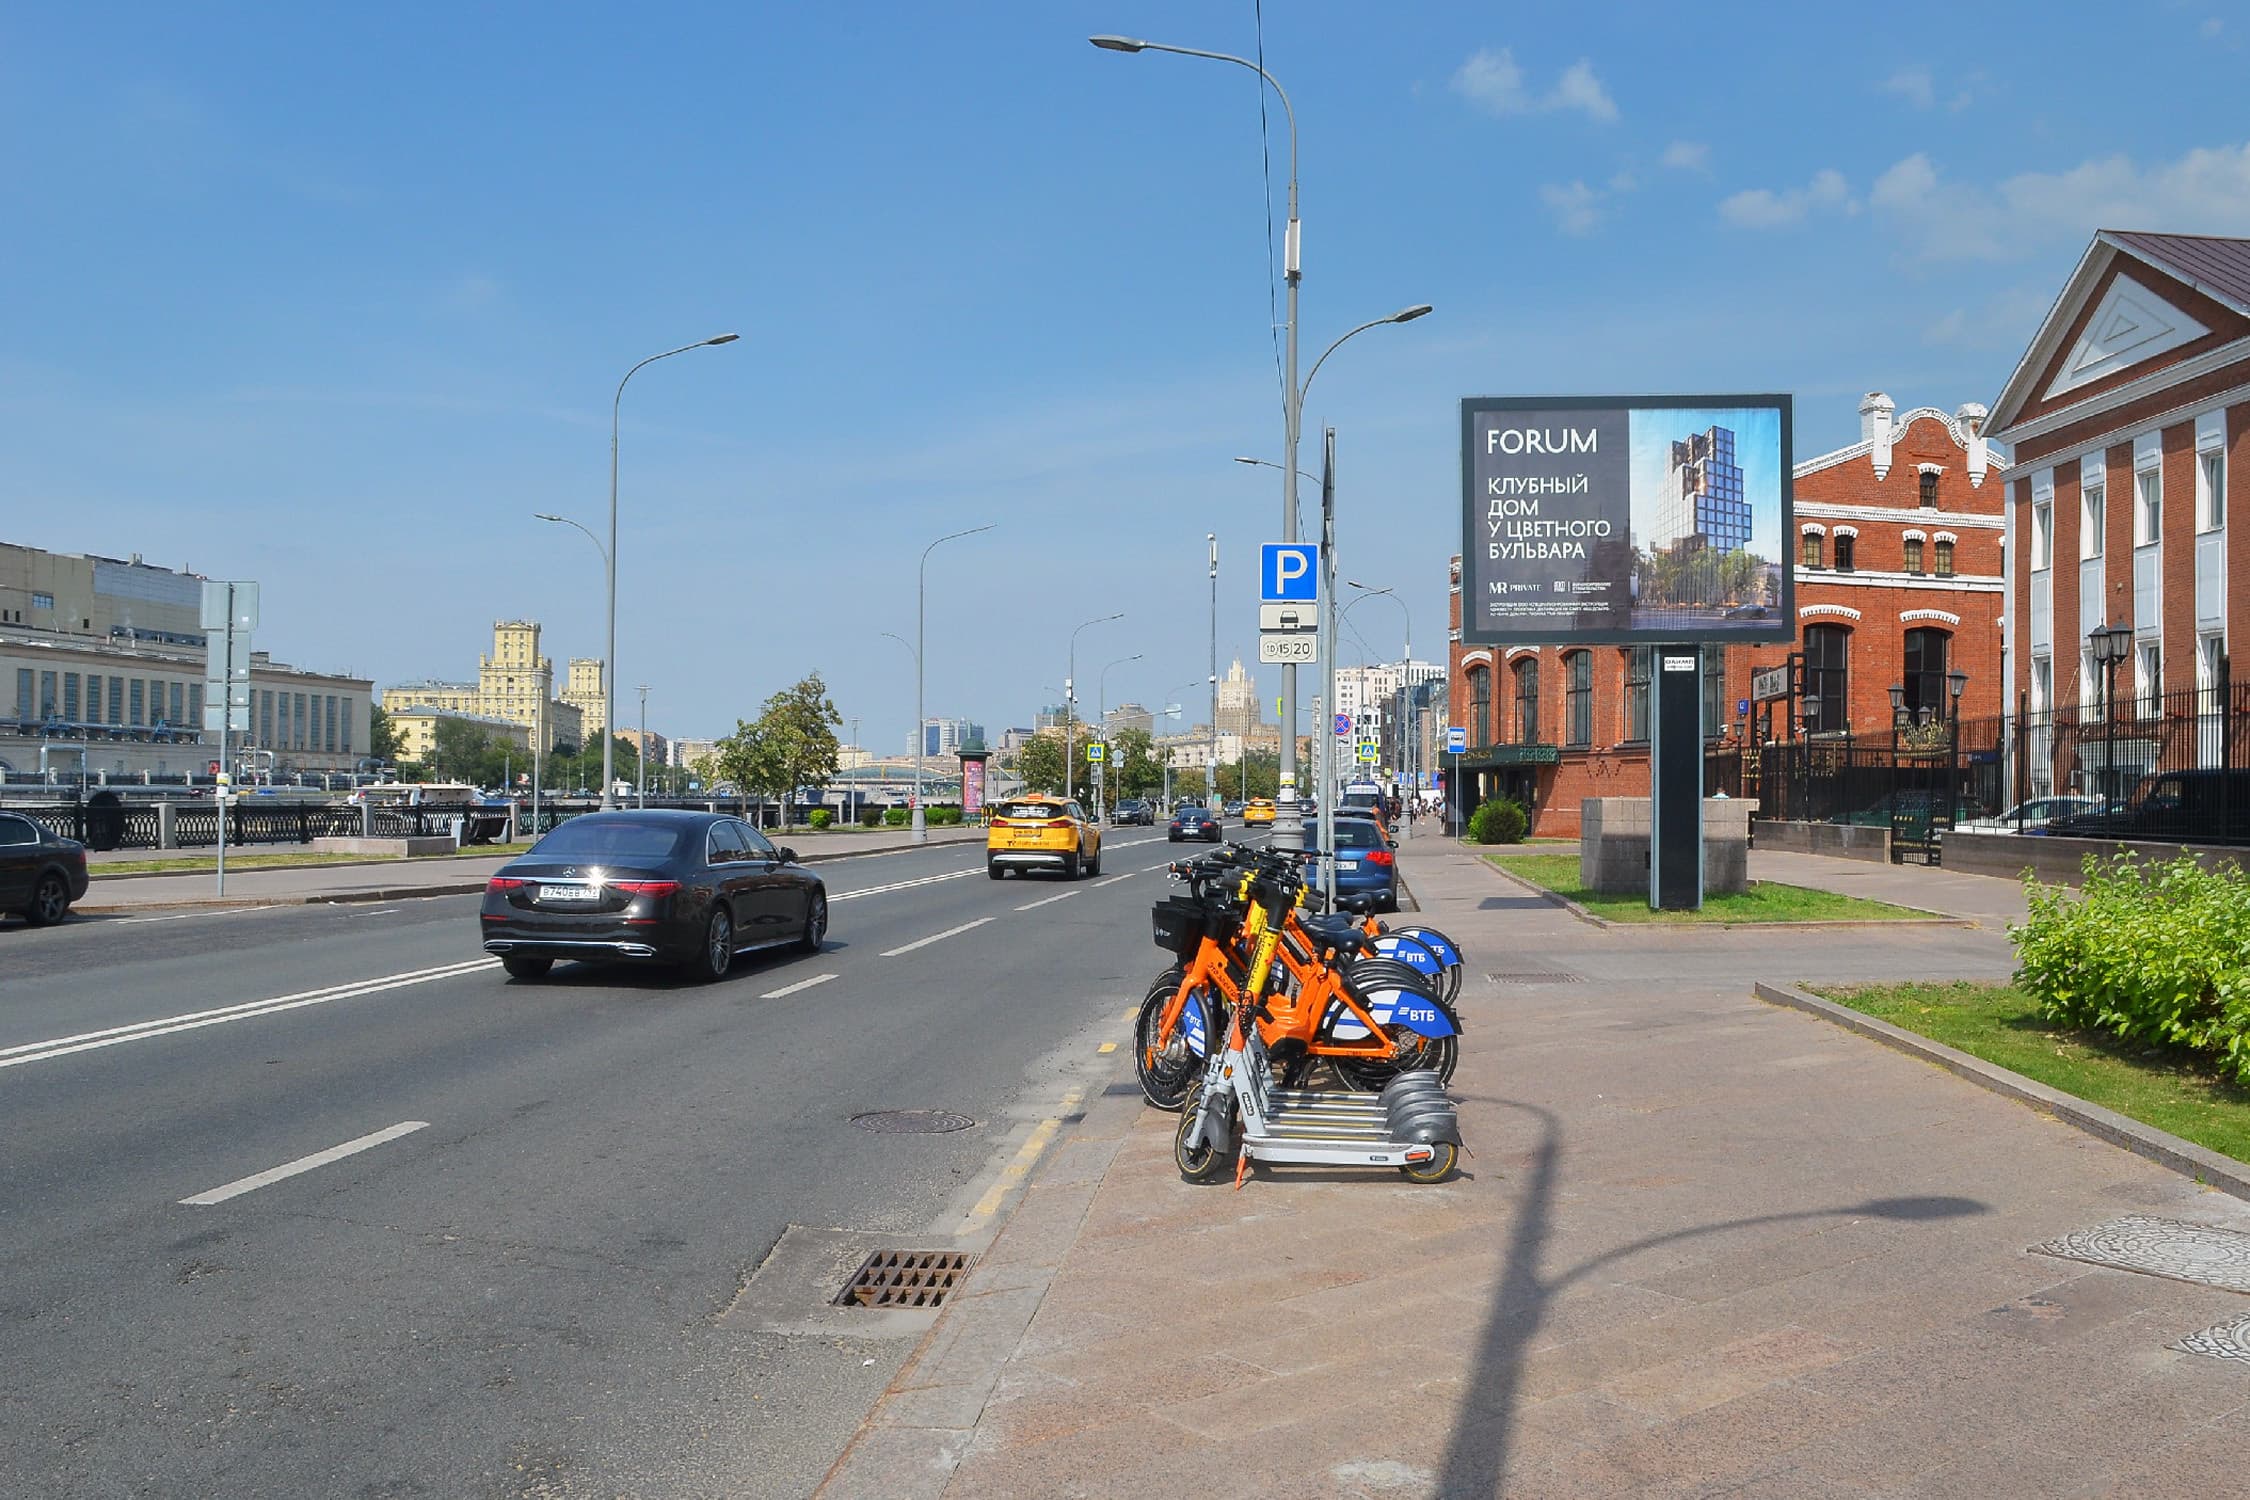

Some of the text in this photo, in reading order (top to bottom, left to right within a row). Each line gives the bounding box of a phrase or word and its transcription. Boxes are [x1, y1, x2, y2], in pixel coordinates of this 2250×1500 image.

[1487, 428, 1597, 454] FORUM
[1488, 473, 1588, 495] КЛУБНЫЙ
[1487, 499, 1539, 519] ДОМ
[1487, 520, 1611, 541] У ЦВЕТНОГО
[1489, 542, 1586, 559] БУЛЬВАРА
[1276, 550, 1308, 595] P
[1489, 582, 1508, 594] MR
[1510, 584, 1542, 592] PRIVATE
[1279, 643, 1290, 654] 15
[1293, 642, 1310, 655] 20
[1406, 952, 1426, 963] ВТБ
[1410, 1010, 1435, 1021] ВТБ
